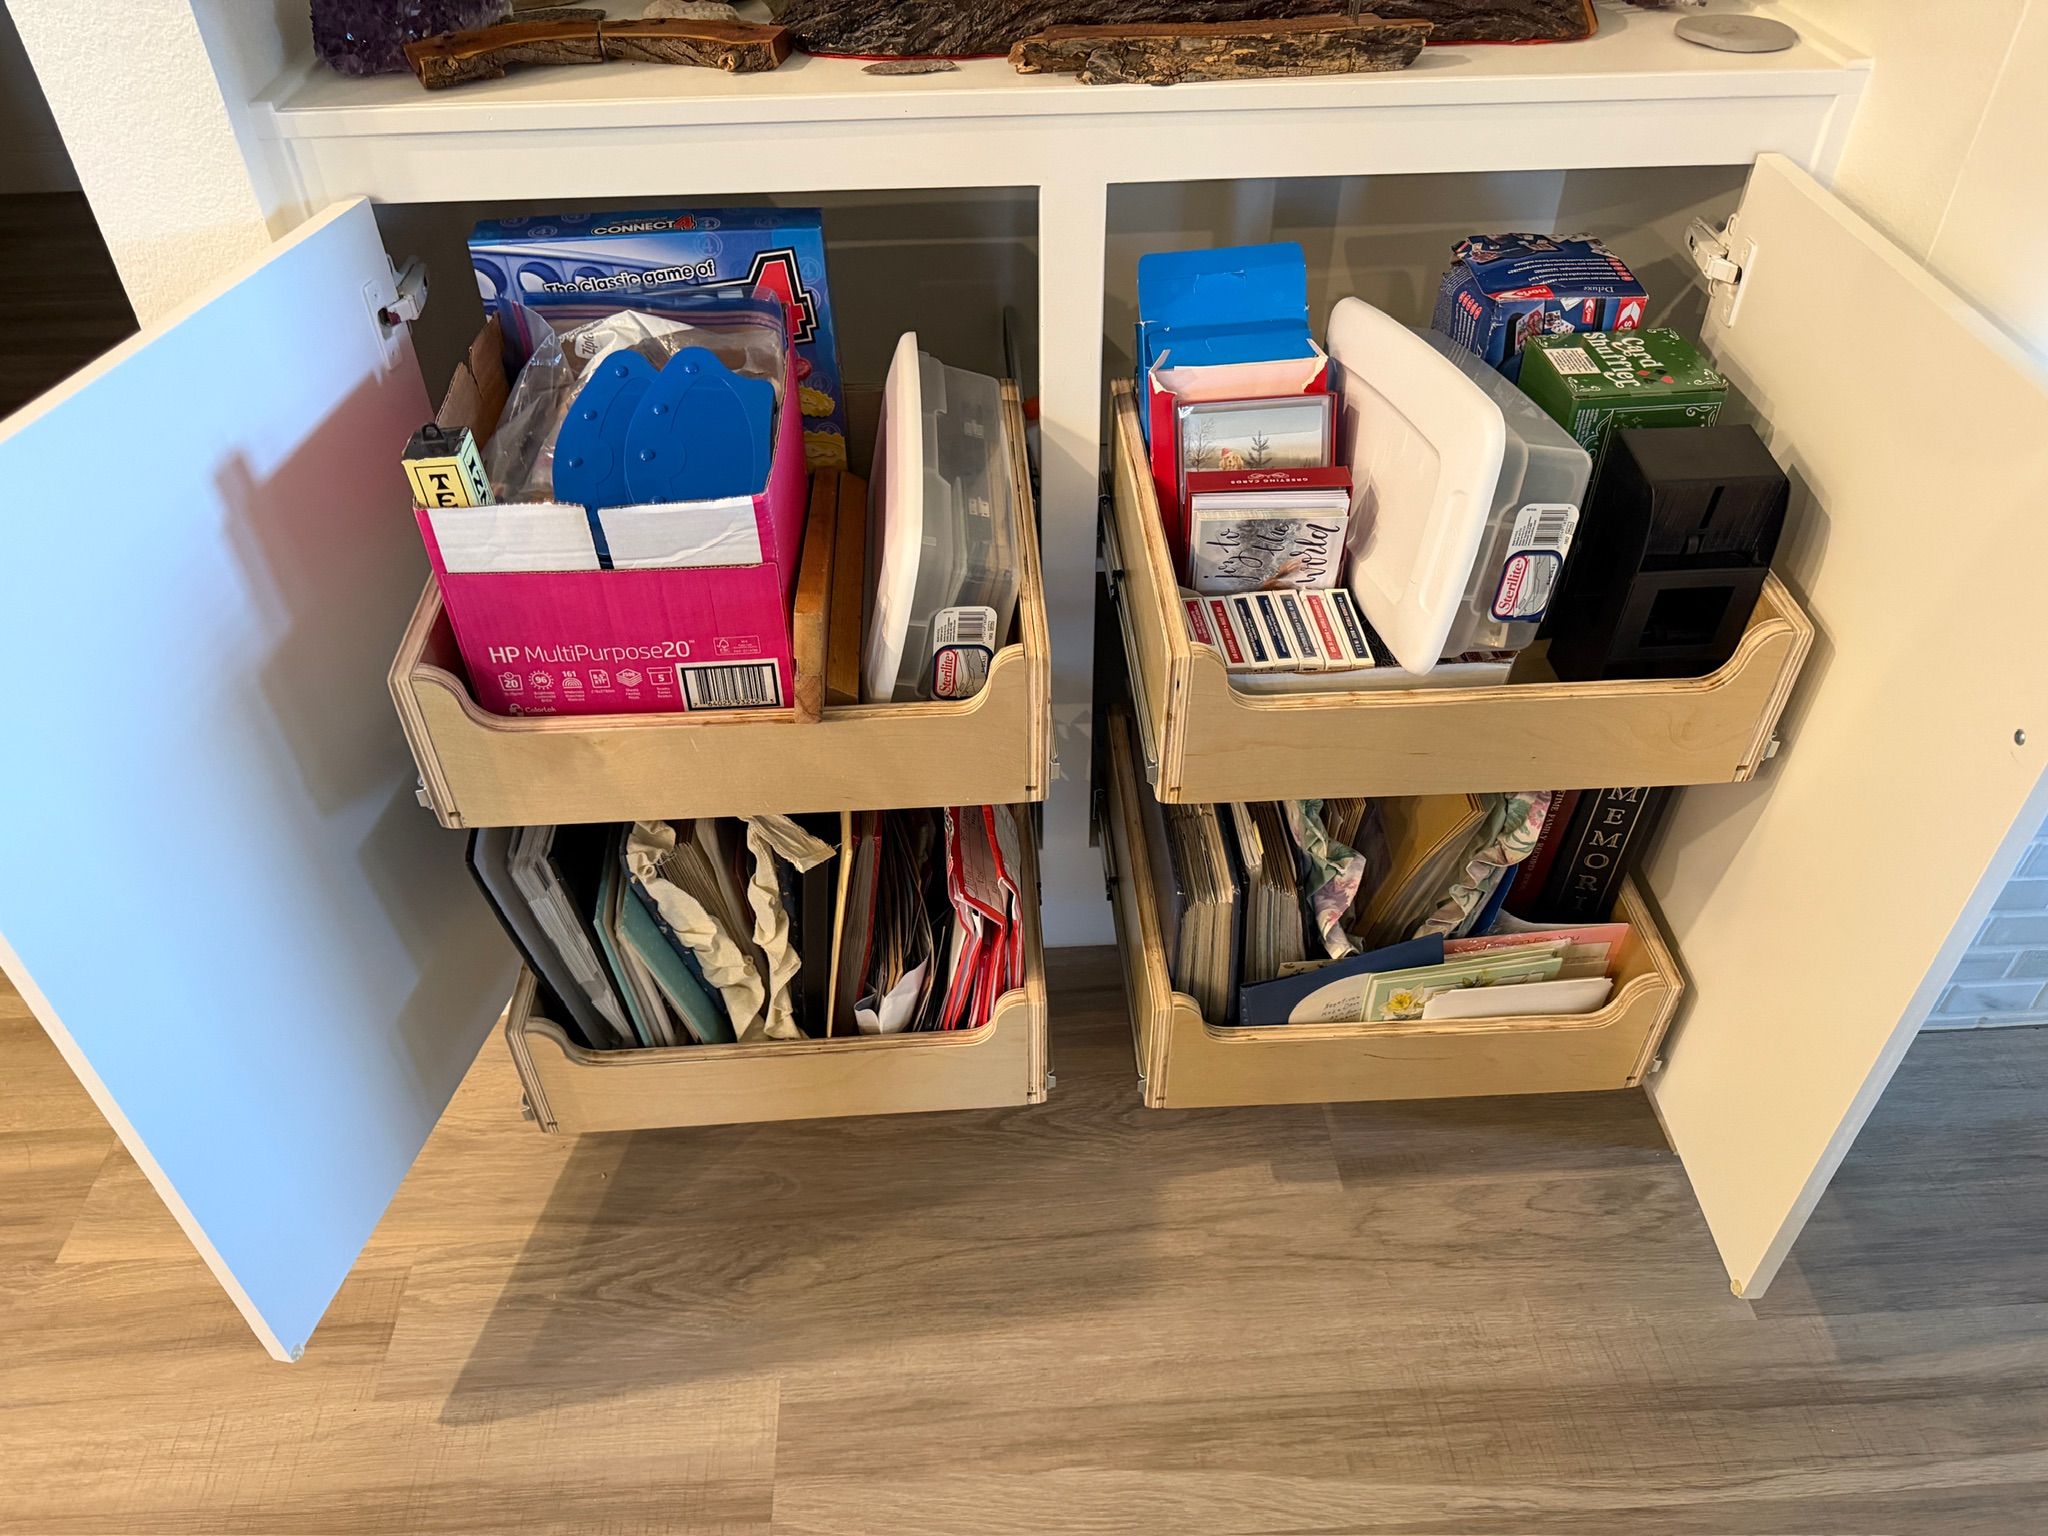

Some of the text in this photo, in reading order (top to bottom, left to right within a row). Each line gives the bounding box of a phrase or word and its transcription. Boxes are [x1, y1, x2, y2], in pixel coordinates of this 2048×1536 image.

[580, 271, 640, 293] classic
[644, 265, 695, 285] game
[695, 258, 716, 278] of
[1516, 288, 1548, 297] noris
[1583, 332, 1641, 389] Shuffler
[1611, 337, 1665, 368] Card
[1289, 523, 1340, 584] world
[1499, 562, 1523, 610] Sterilite
[488, 646, 520, 664] HP
[504, 680, 519, 688] 20
[562, 670, 577, 678] 161
[658, 674, 665, 682] 5
[939, 654, 953, 693] Sterilite
[1539, 813, 1556, 841] FAMILY
[1527, 842, 1545, 871] RECORD
